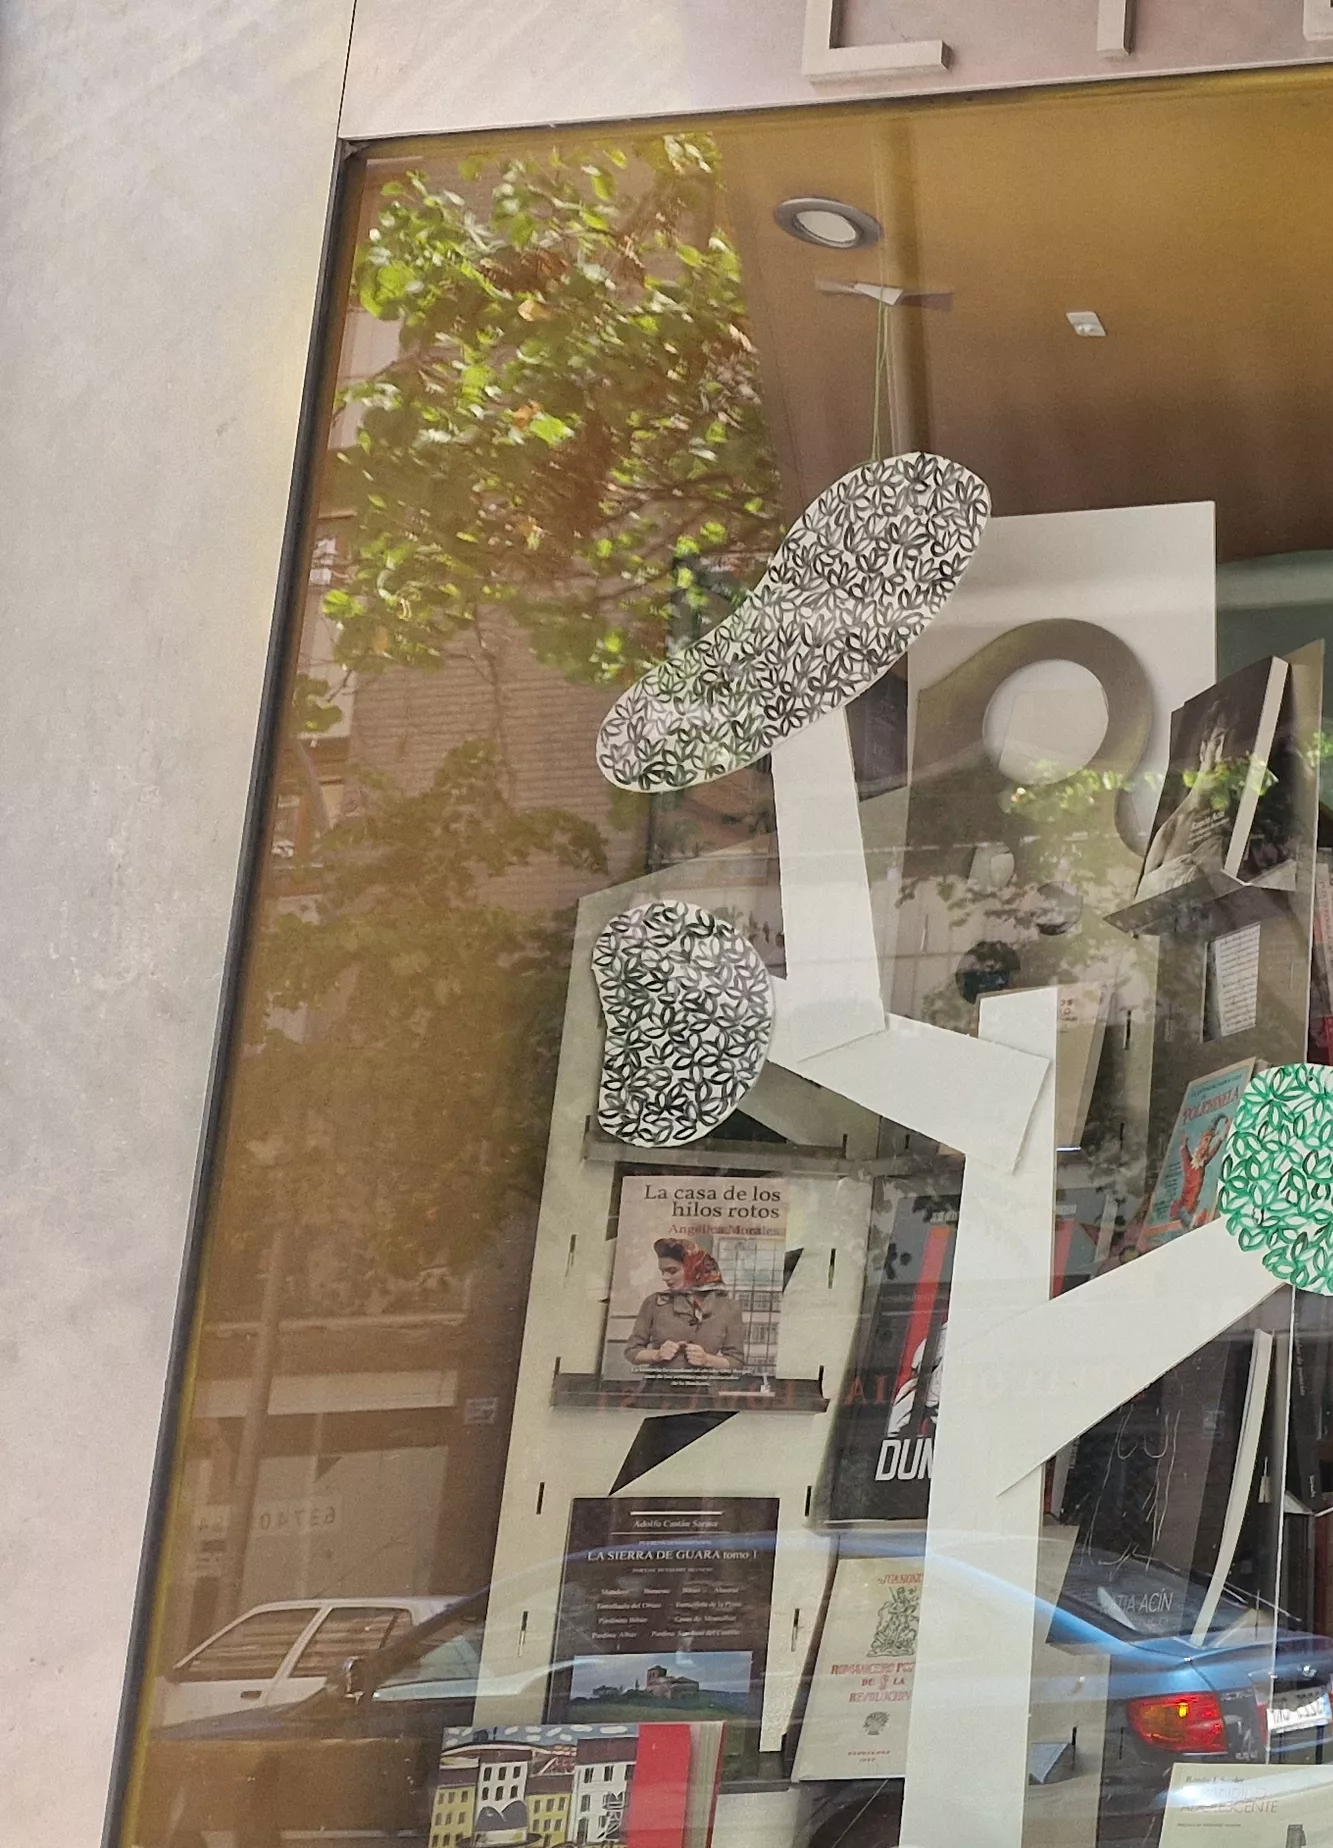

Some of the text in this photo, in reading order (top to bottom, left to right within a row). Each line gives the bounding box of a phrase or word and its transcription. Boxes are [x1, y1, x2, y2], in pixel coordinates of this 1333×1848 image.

[645, 1184, 781, 1202] La casa de los
[672, 1202, 780, 1219] hilos rotos
[633, 1519, 662, 1528] Adolfo
[587, 1551, 604, 1561] LA
[607, 1551, 653, 1560] SIERRA
[656, 1551, 673, 1560] DE
[676, 1550, 720, 1560] GUARA
[723, 1552, 749, 1560] tomo
[861, 1677, 905, 1687] DE LA
